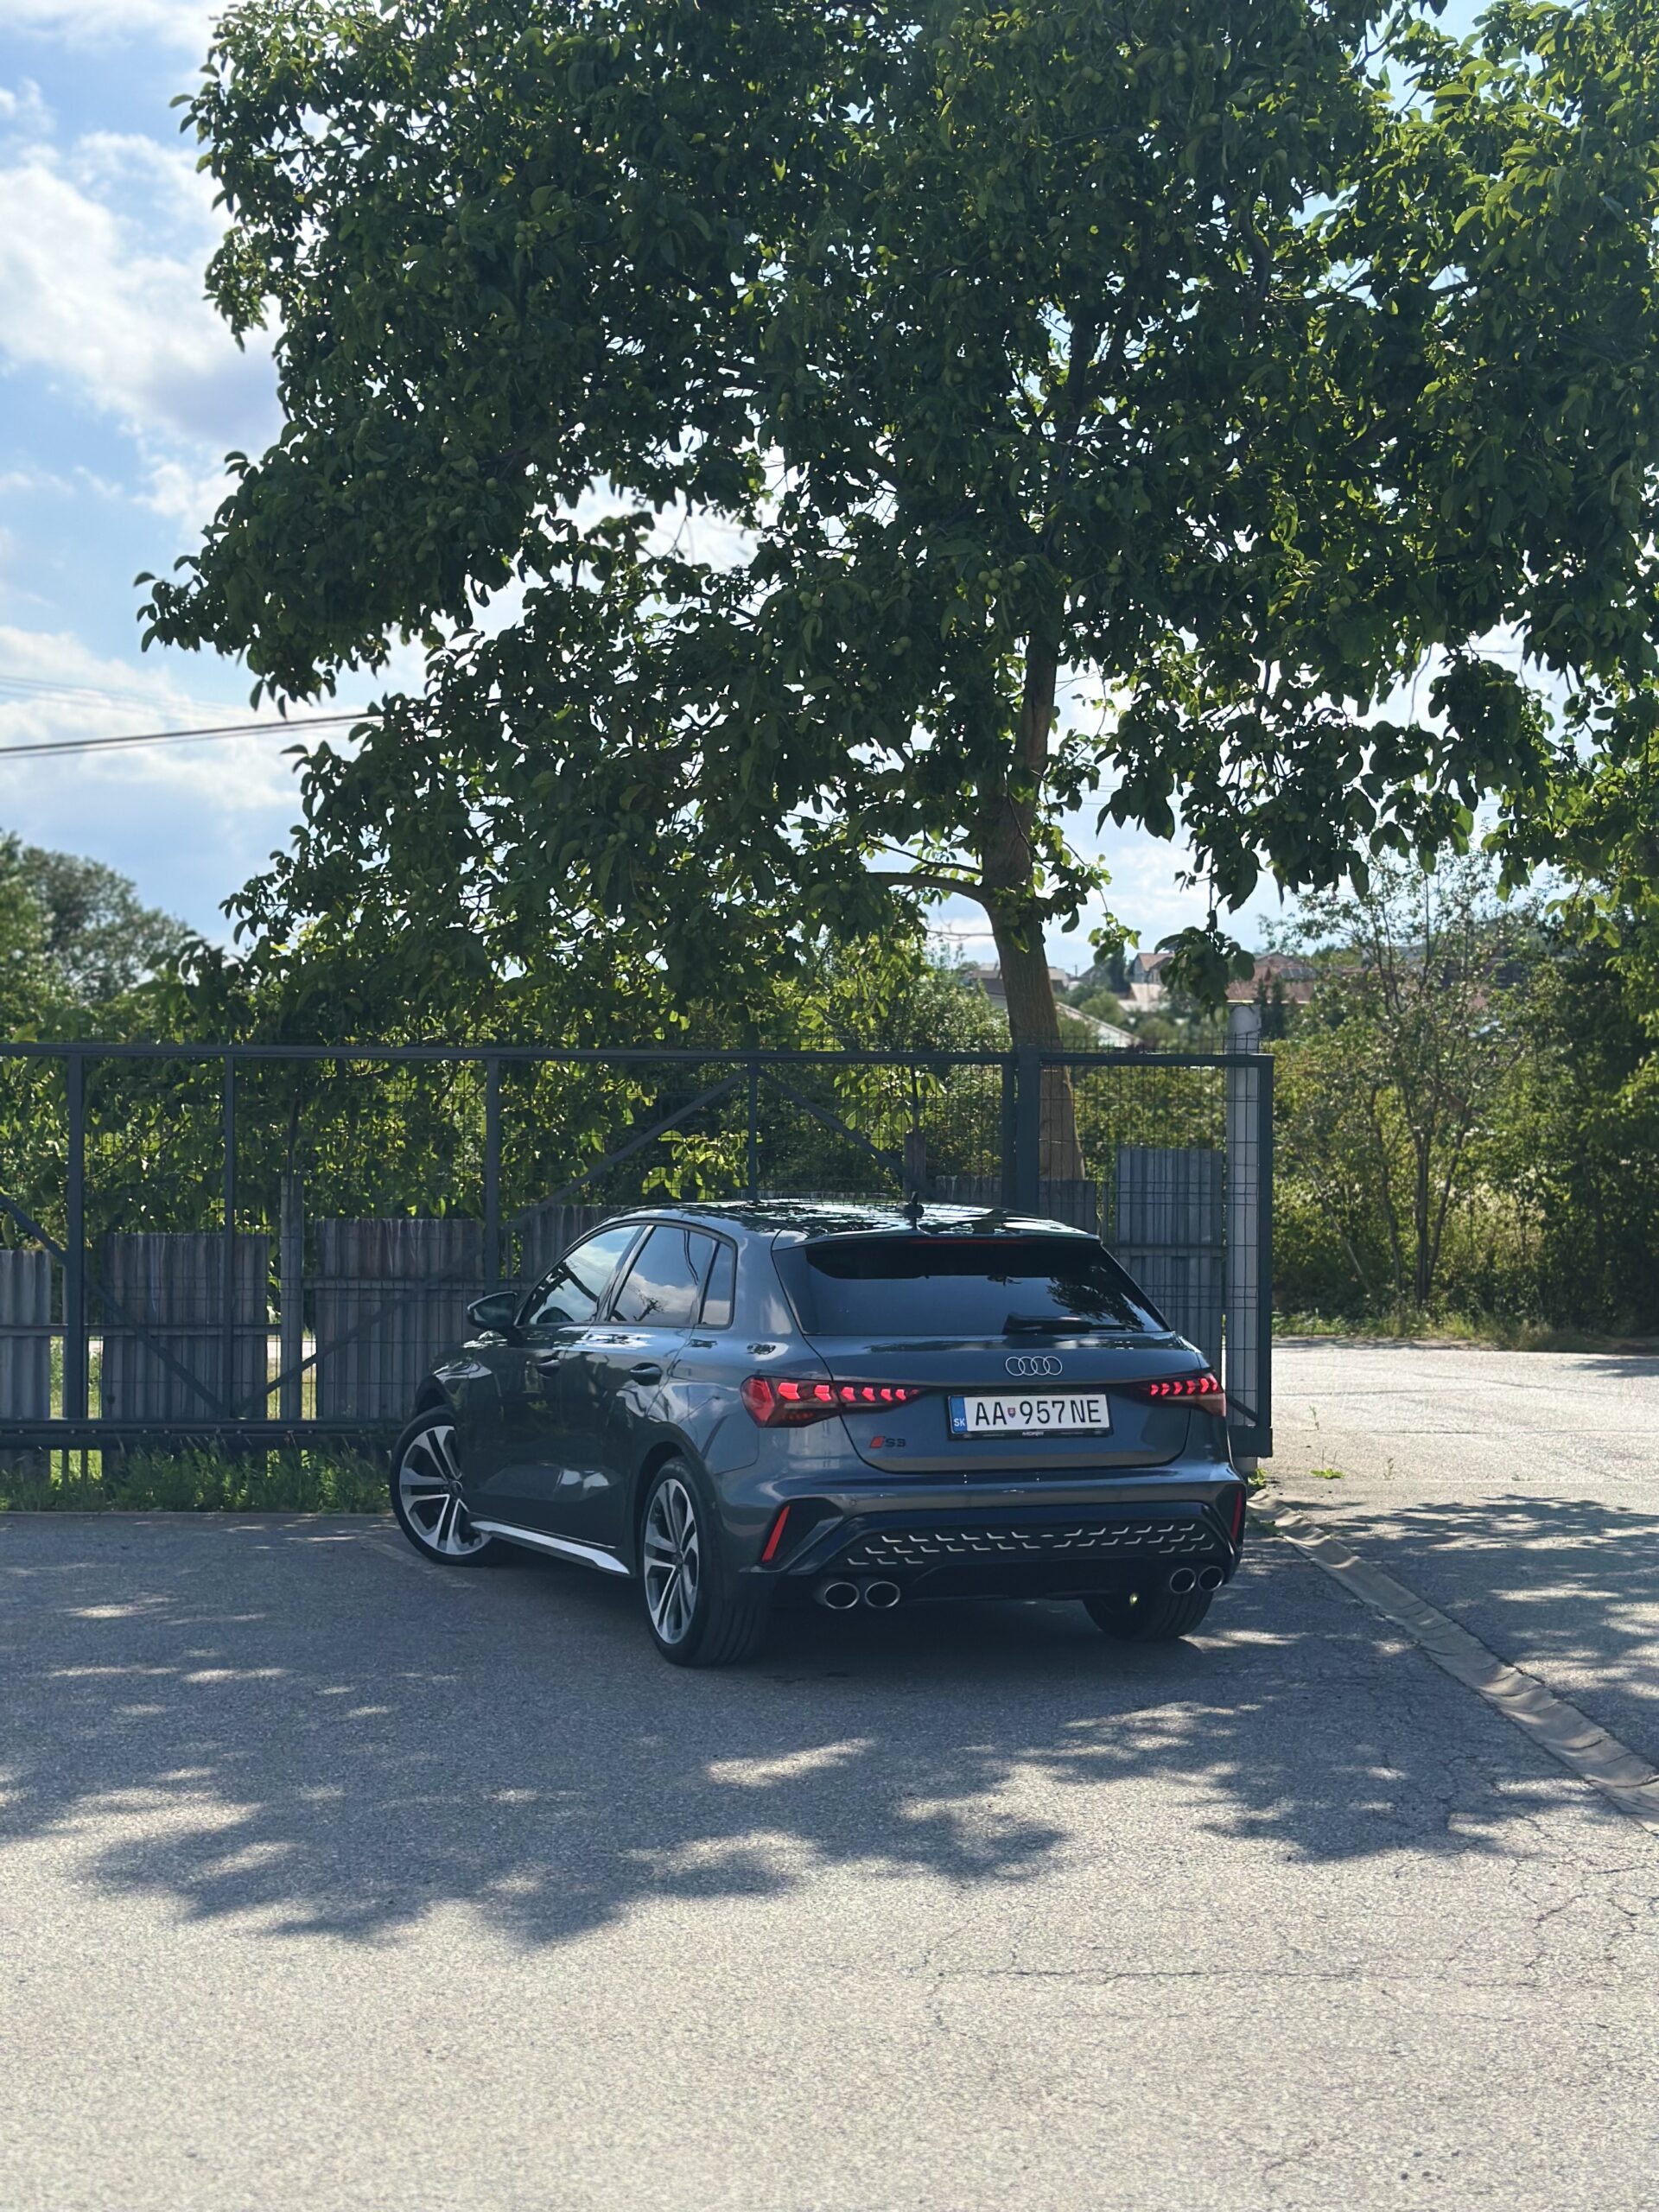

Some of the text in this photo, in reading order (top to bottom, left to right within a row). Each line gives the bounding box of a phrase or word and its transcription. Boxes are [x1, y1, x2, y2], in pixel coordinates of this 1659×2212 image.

[976, 1402, 1007, 1426] AA
[954, 1418, 965, 1427] SK
[885, 1438, 906, 1447] S3
